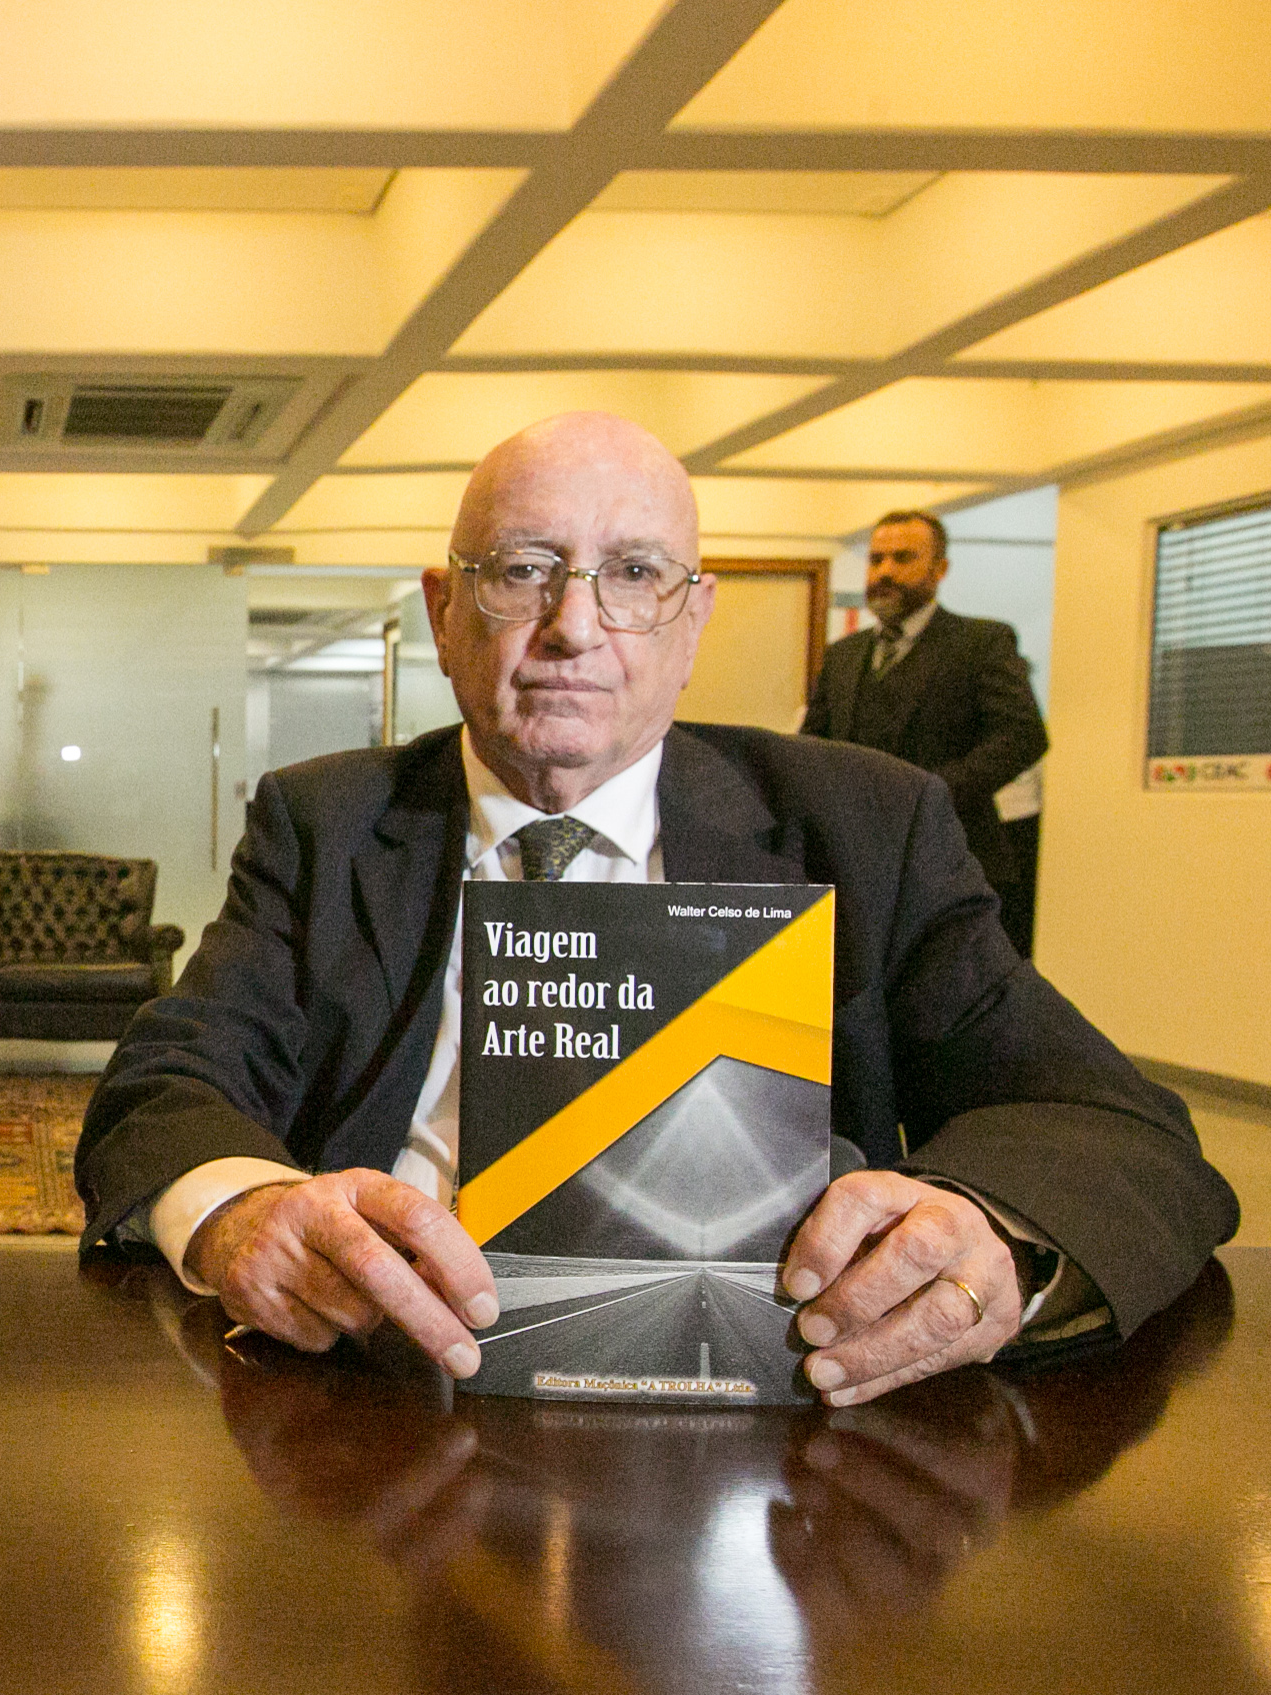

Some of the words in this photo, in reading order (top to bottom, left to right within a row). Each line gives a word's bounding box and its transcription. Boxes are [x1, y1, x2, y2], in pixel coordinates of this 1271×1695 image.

[667, 905, 706, 918] Walter
[708, 906, 742, 919] Celso
[744, 906, 760, 919] de
[763, 907, 792, 919] Lima
[484, 922, 597, 963] Viagem
[483, 978, 519, 1007] ao
[527, 973, 611, 1009] redor
[618, 975, 655, 1010] da
[481, 1021, 545, 1057] Arte
[554, 1022, 620, 1059] Real
[537, 1376, 580, 1389] Editora
